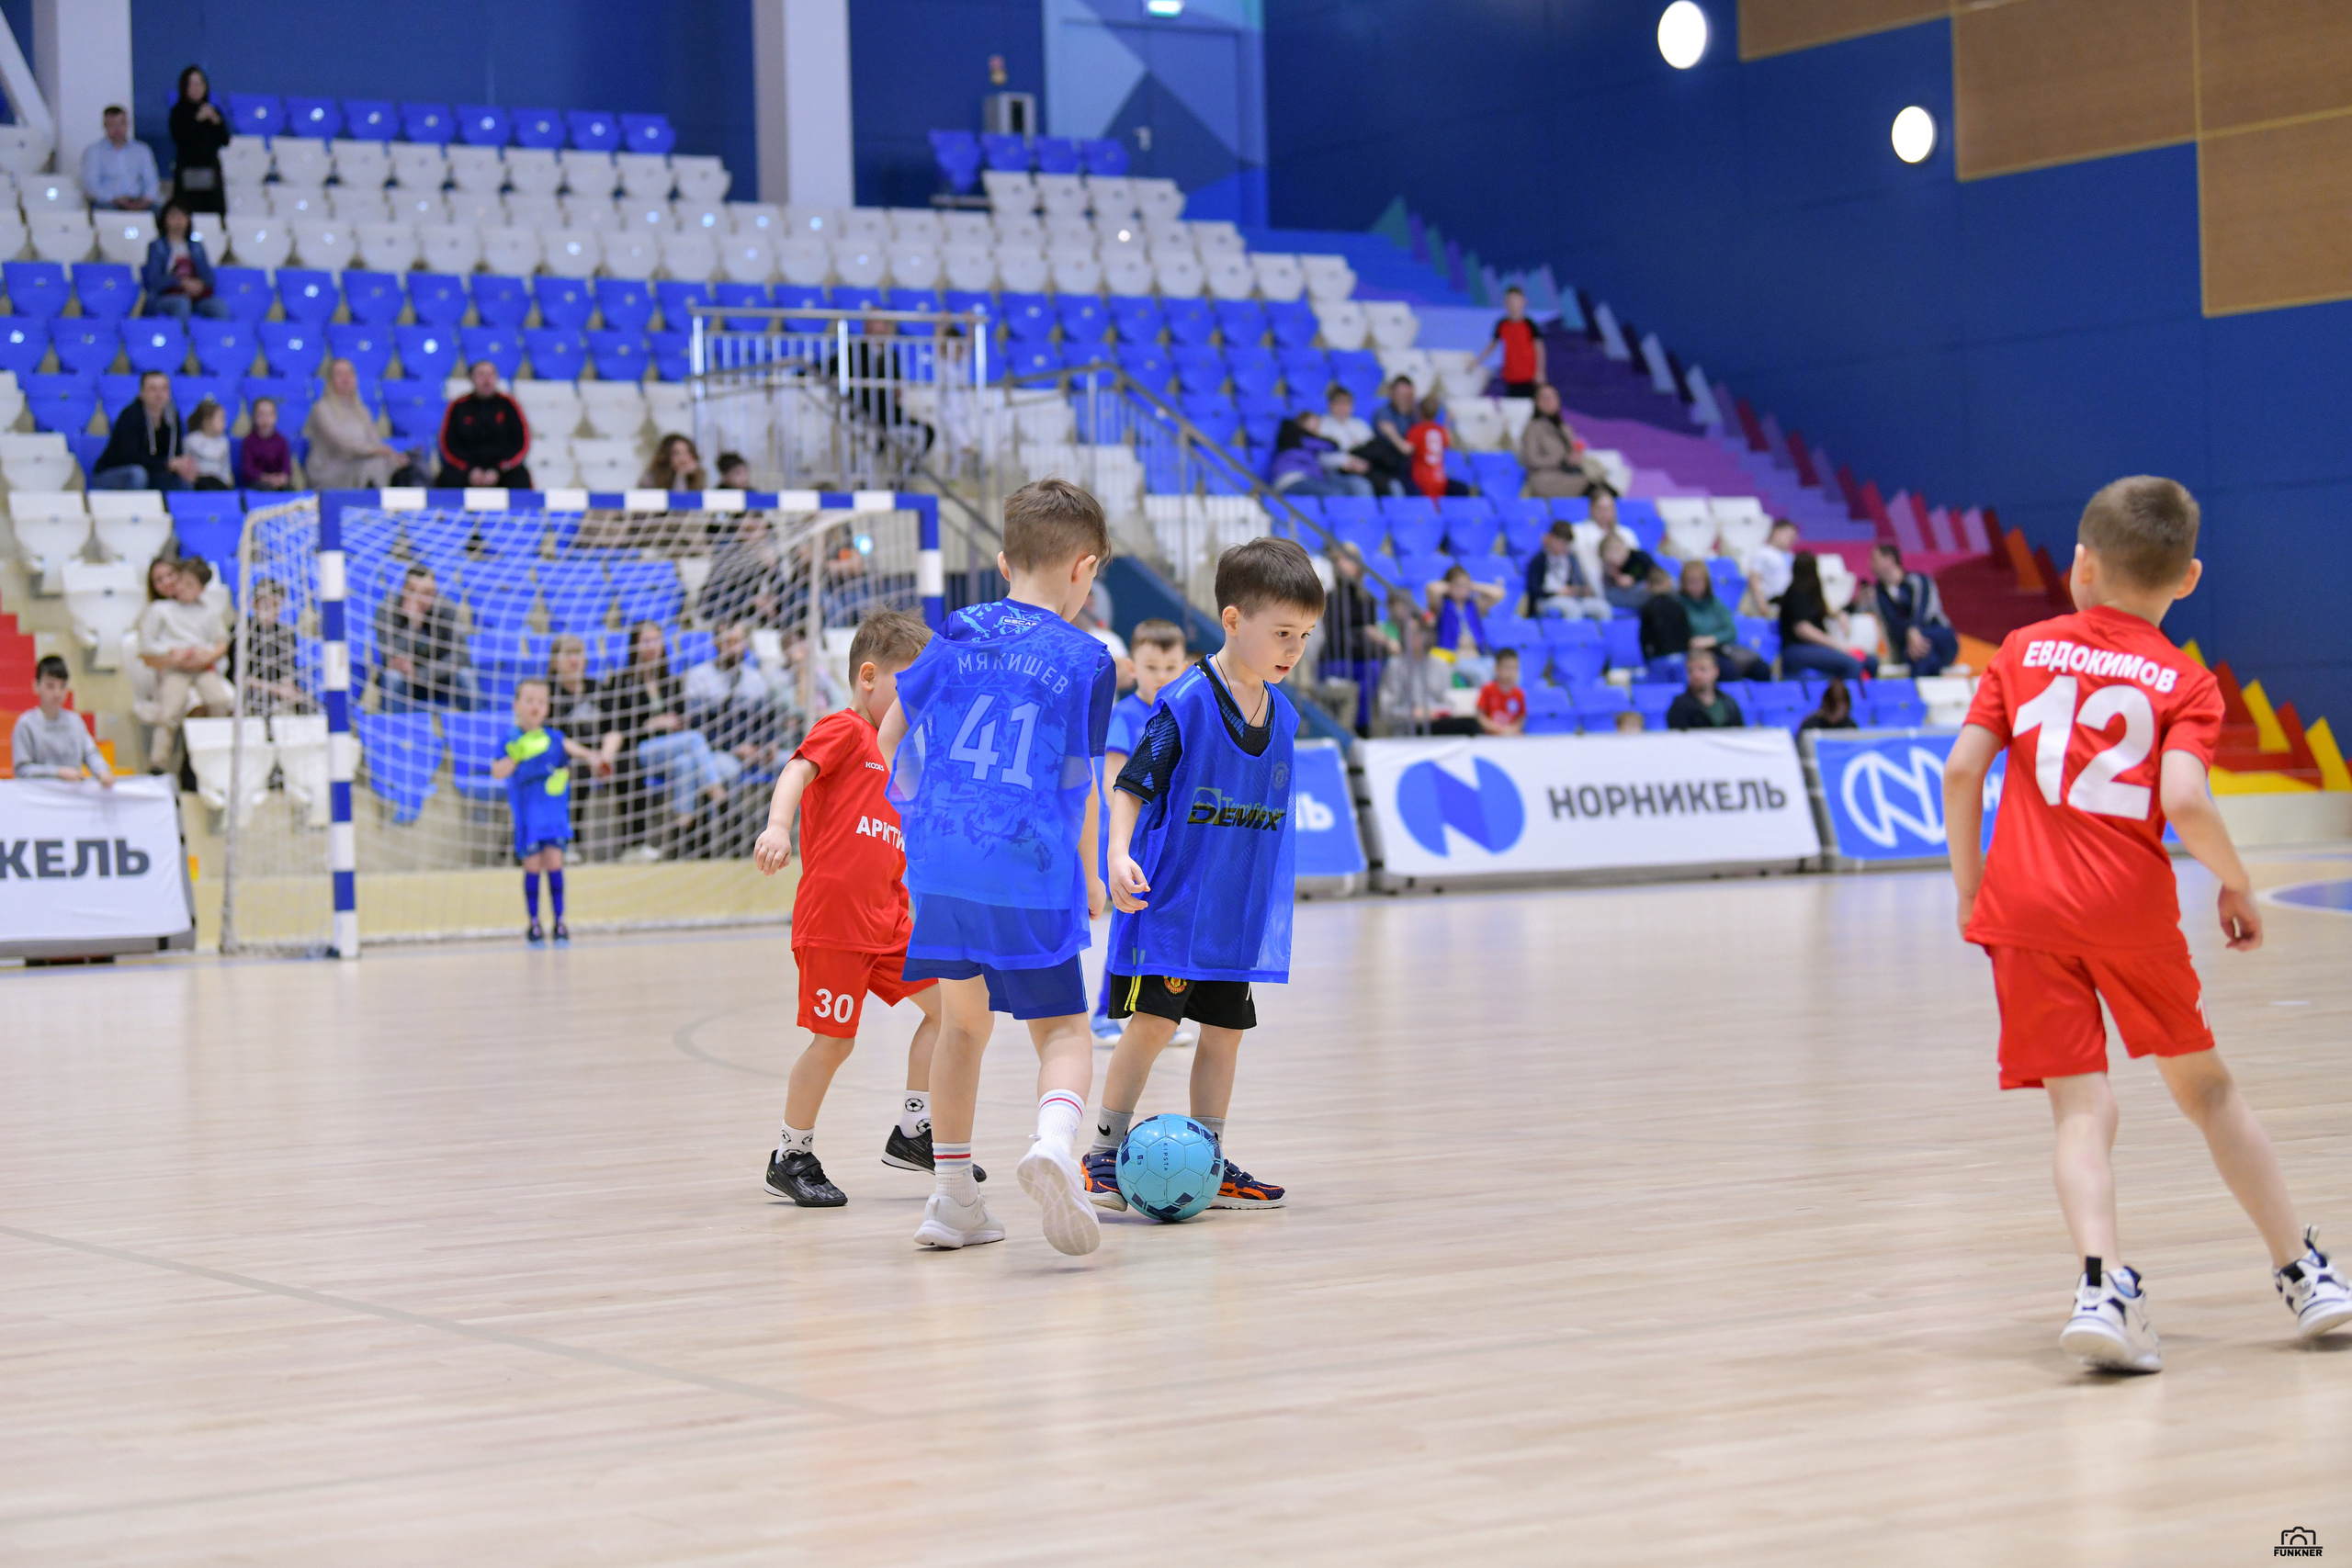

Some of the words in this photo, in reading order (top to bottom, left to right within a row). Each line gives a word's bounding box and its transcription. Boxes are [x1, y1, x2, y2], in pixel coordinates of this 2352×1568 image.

[957, 651, 1069, 695] МЯКИШЕВ
[2022, 640, 2178, 694] ЕВДОКИМОВ
[948, 694, 1042, 791] 41
[2012, 674, 2155, 821] 12
[1547, 779, 1787, 819] НОРНИКЕЛЬ
[813, 987, 854, 1024] 30
